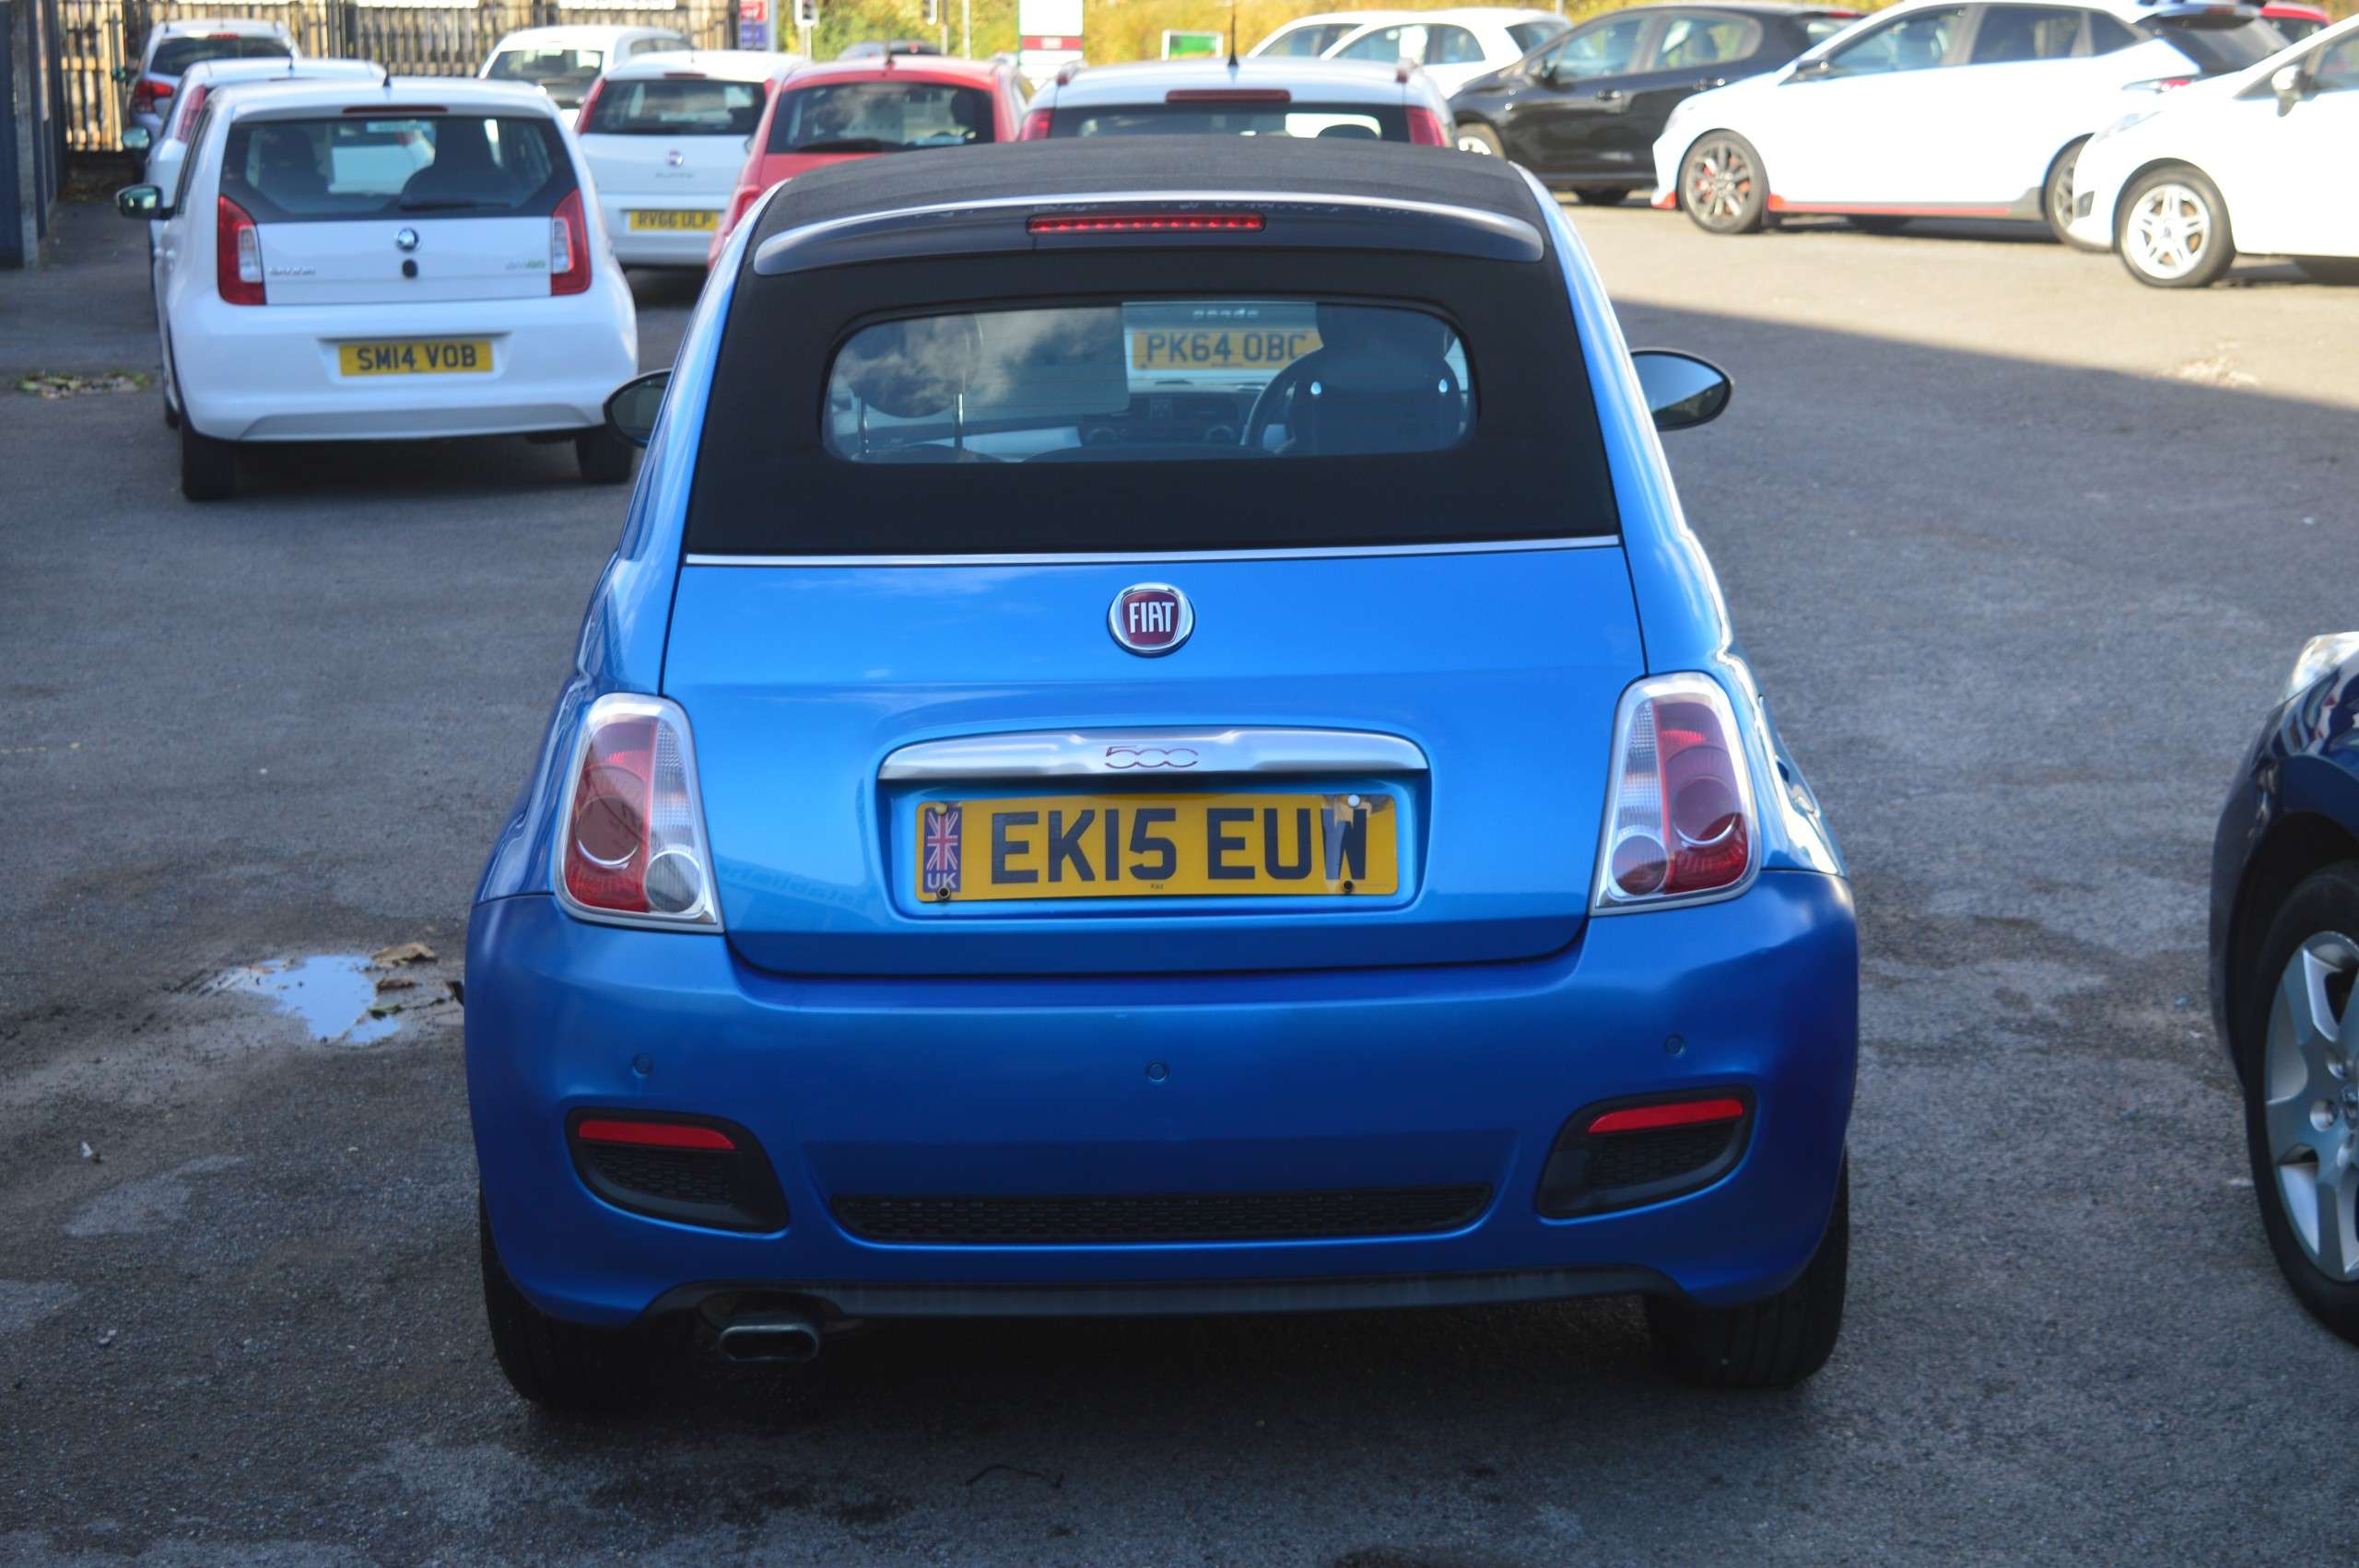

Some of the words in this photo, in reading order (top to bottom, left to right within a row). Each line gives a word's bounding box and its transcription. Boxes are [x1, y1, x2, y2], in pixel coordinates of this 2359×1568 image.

[357, 346, 417, 370] SM14
[425, 345, 476, 369] VOB
[1147, 333, 1233, 362] PK64
[1129, 601, 1175, 634] FIAT
[1105, 745, 1198, 769] 500
[991, 807, 1177, 884] EK15
[1206, 807, 1367, 881] EUW
[927, 872, 957, 889] UK
